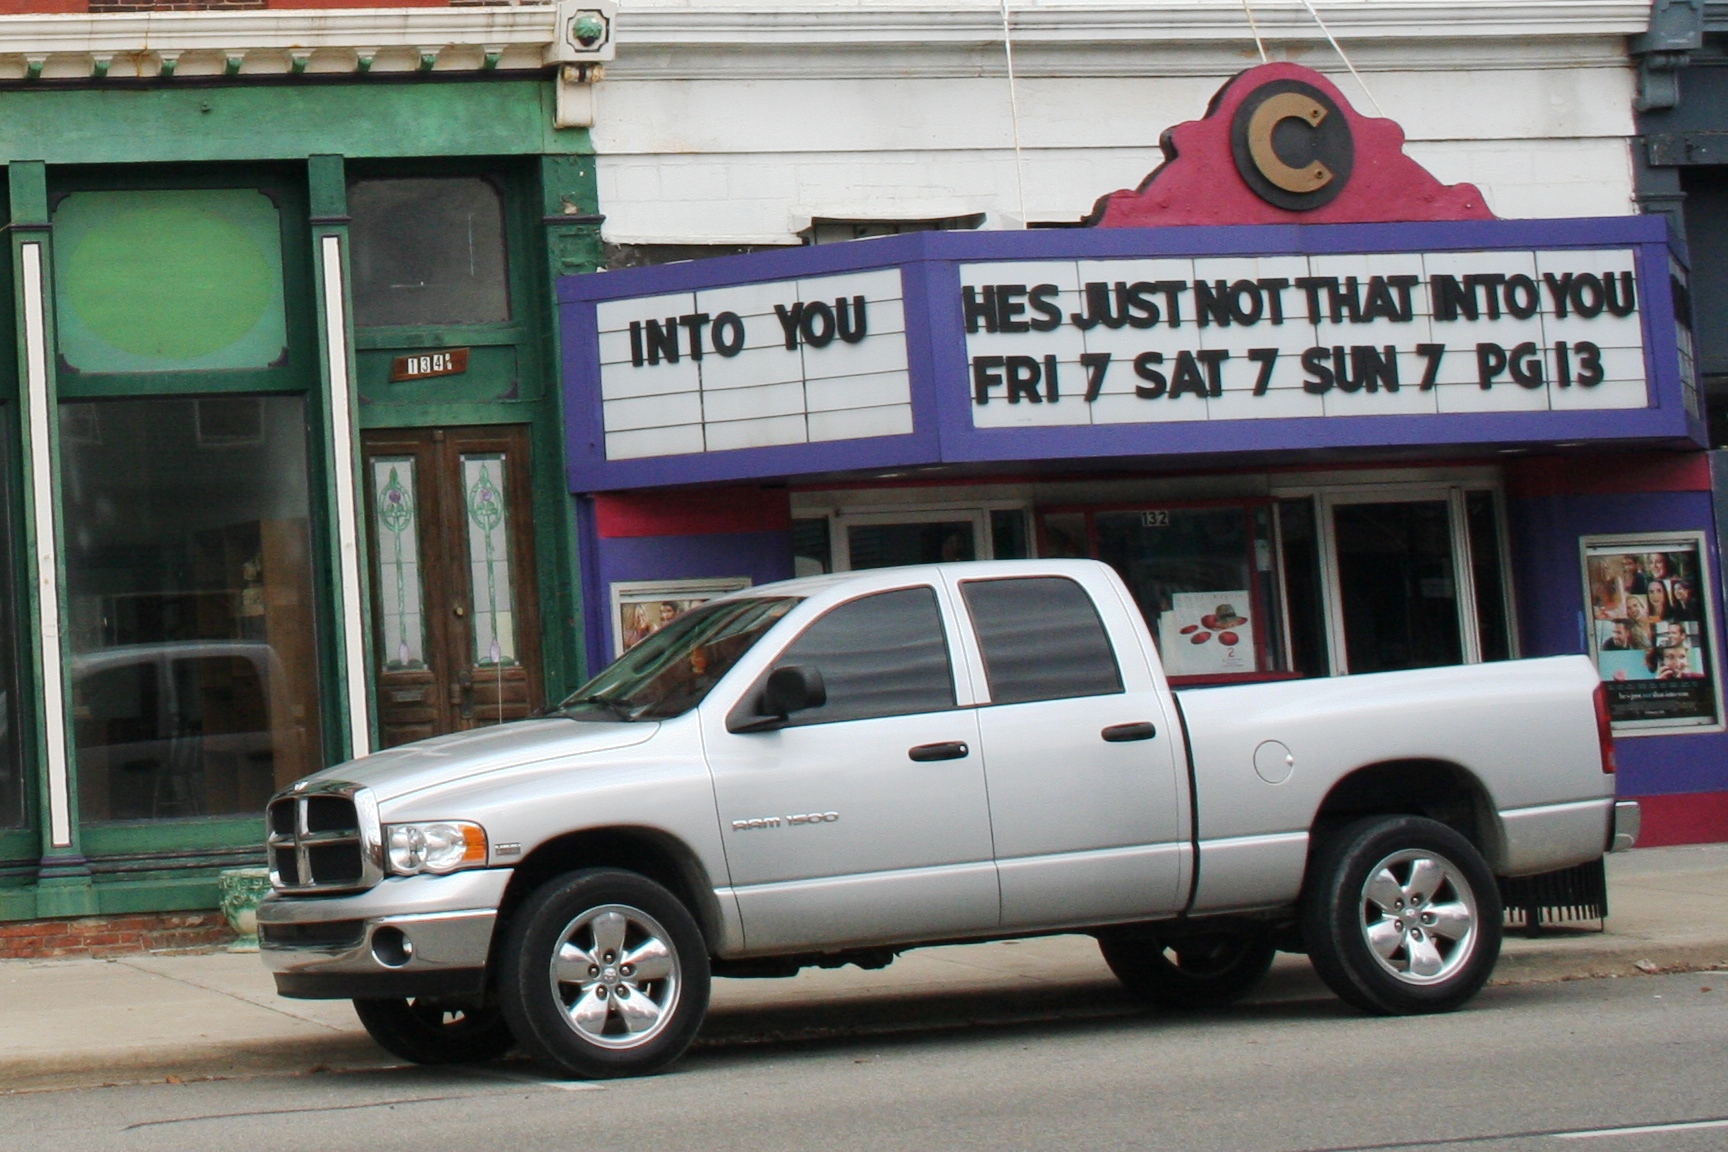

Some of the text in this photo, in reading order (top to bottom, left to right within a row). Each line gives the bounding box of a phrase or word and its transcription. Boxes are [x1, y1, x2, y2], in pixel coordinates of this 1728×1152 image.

[1248, 92, 1334, 193] C
[629, 295, 868, 367] INTO YOU
[962, 283, 1062, 333] HES
[1070, 280, 1187, 330] JUST
[1194, 277, 1289, 327] NOT
[1294, 274, 1419, 325] THAT
[1430, 272, 1540, 322] INTO
[1543, 271, 1636, 320] YOU
[973, 354, 1060, 405] FRI
[1080, 352, 1112, 402] 7
[1133, 349, 1230, 400] SAT
[1248, 347, 1280, 397] 7
[1301, 345, 1400, 395] SUN
[1416, 343, 1446, 391] 7
[1142, 510, 1168, 526] 132
[786, 811, 839, 826] 1500
